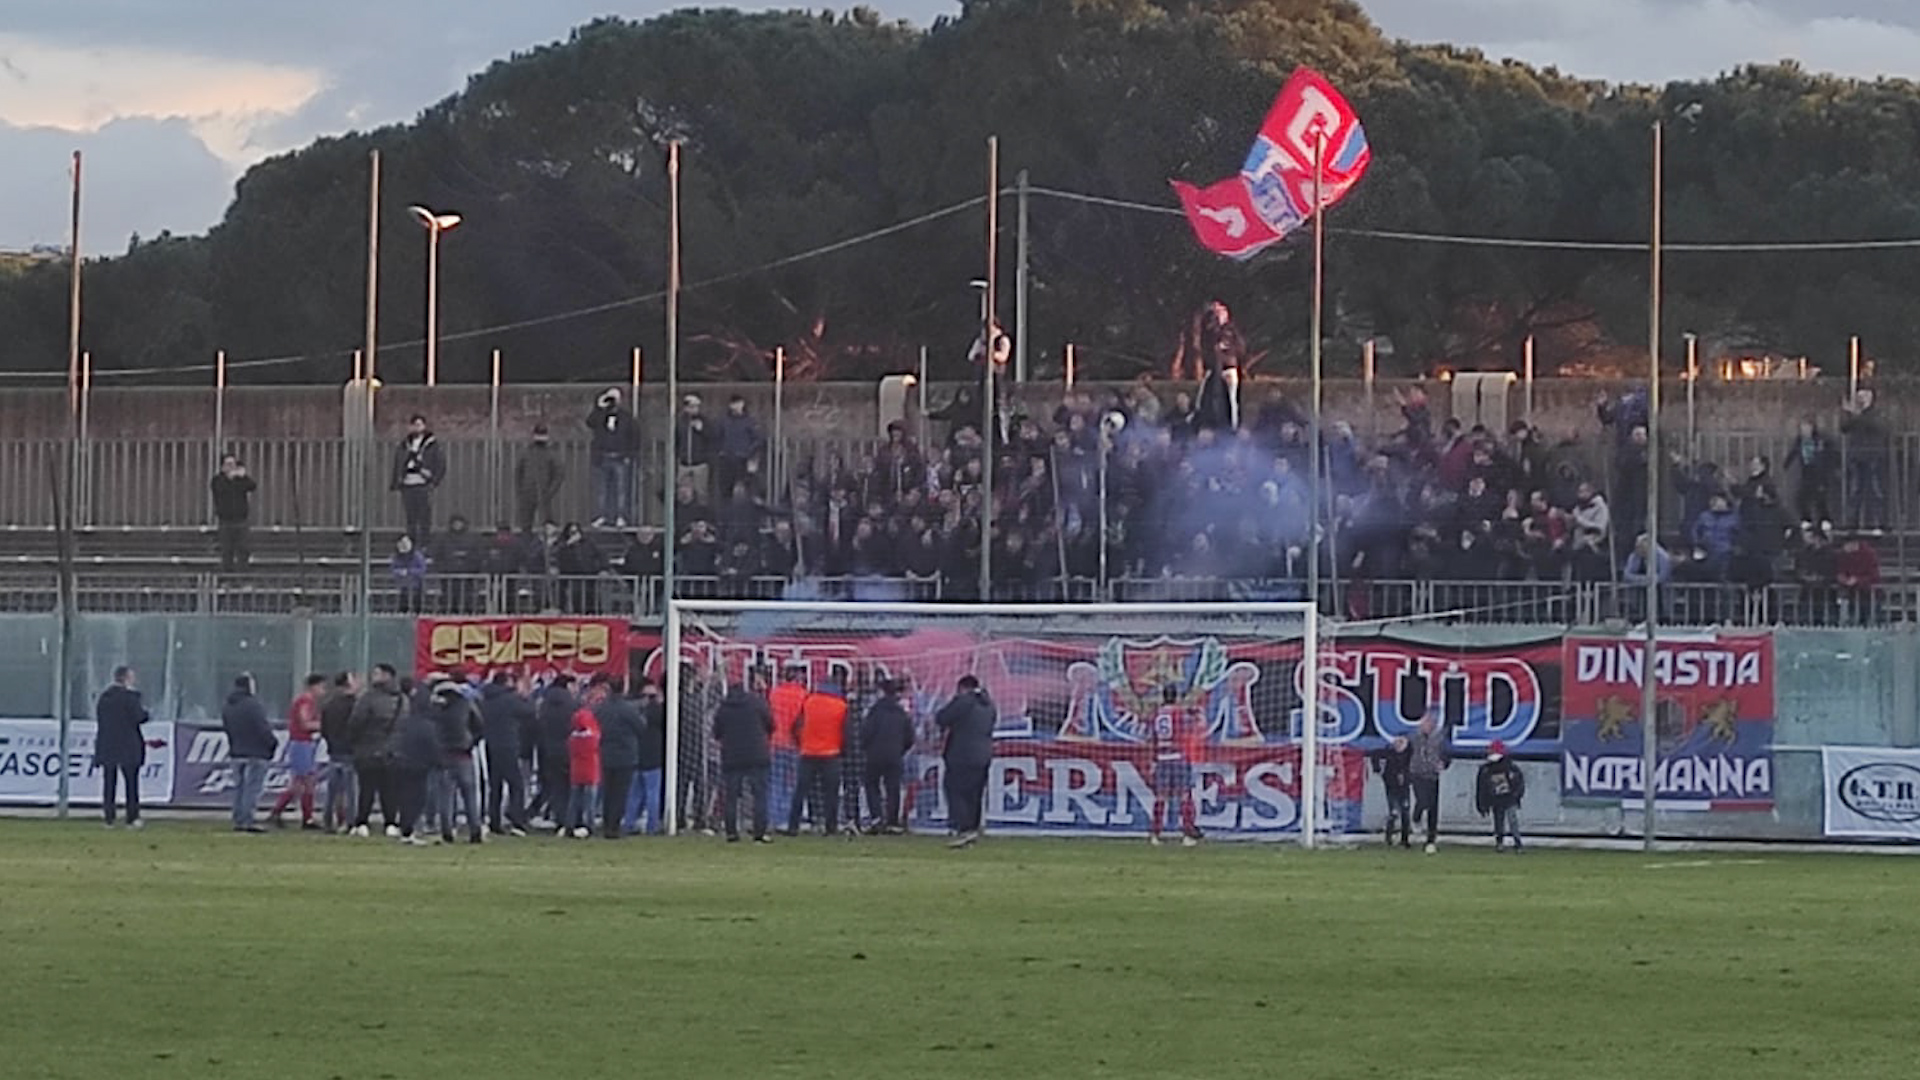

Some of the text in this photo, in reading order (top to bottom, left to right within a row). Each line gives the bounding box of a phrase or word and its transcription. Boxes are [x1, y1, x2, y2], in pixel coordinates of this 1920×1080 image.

[431, 623, 609, 665] GRUPPO
[1577, 643, 1759, 688] DINASTIA
[1293, 652, 1541, 746] SUD
[1564, 750, 1771, 797] NORMANNA
